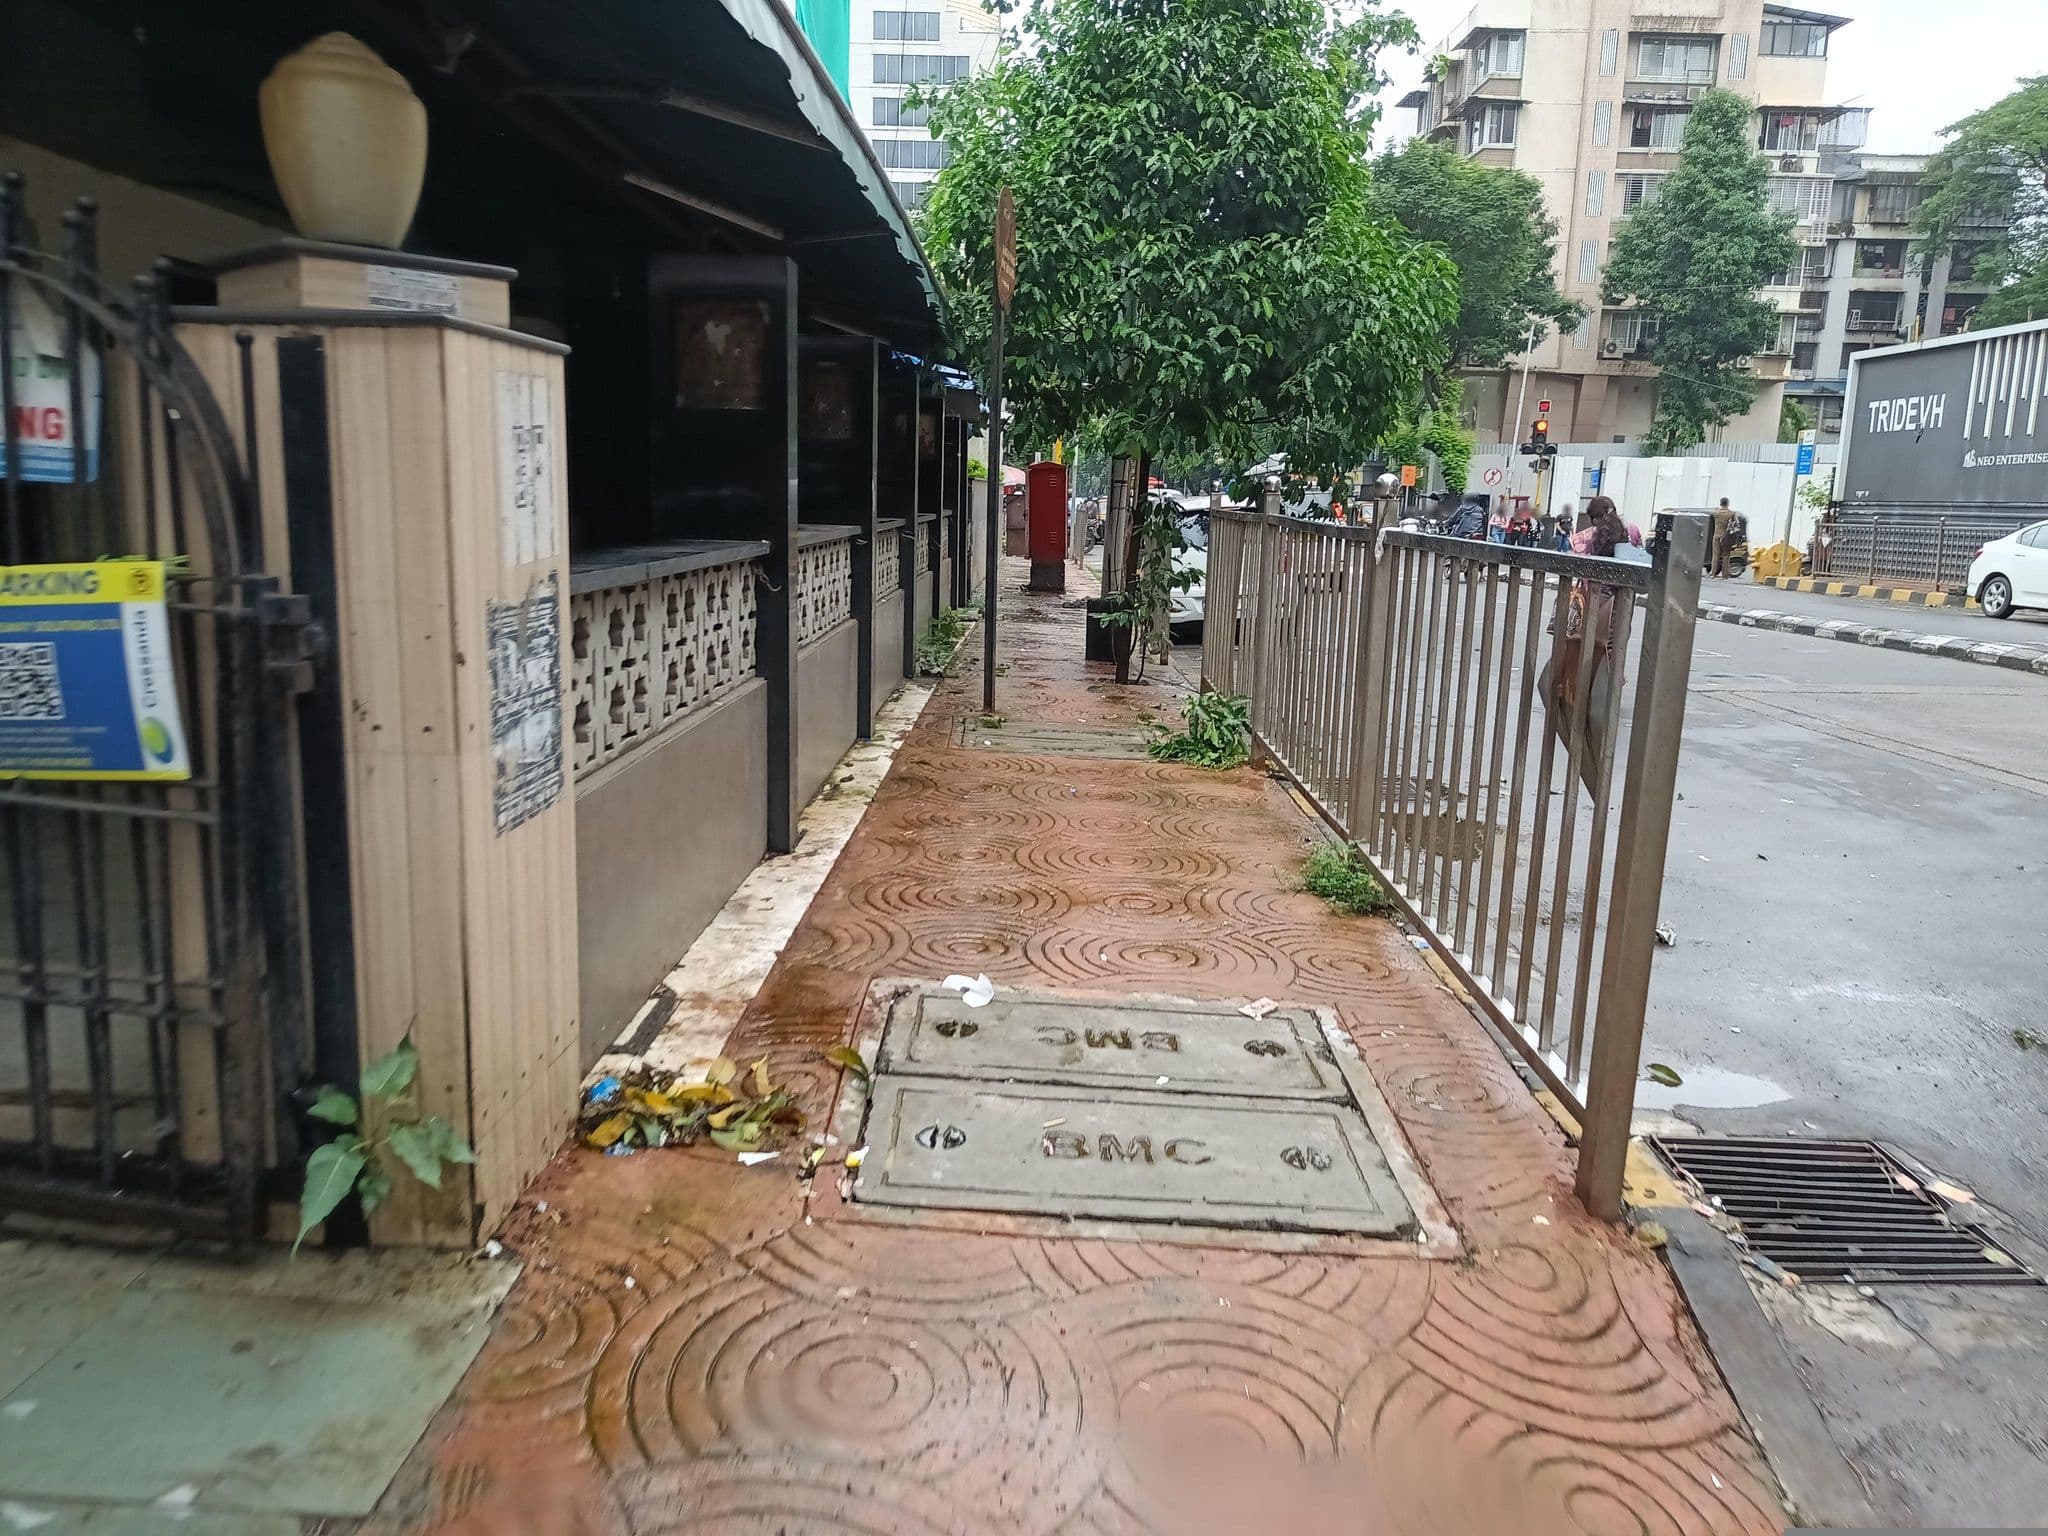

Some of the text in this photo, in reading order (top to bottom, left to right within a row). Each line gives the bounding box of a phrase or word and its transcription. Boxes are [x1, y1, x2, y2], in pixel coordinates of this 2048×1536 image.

[12, 405, 64, 441] NG
[1868, 393, 1946, 434] TRIDEVH
[1977, 455, 1995, 466] NEO
[1042, 1129, 1215, 1166] BMC
